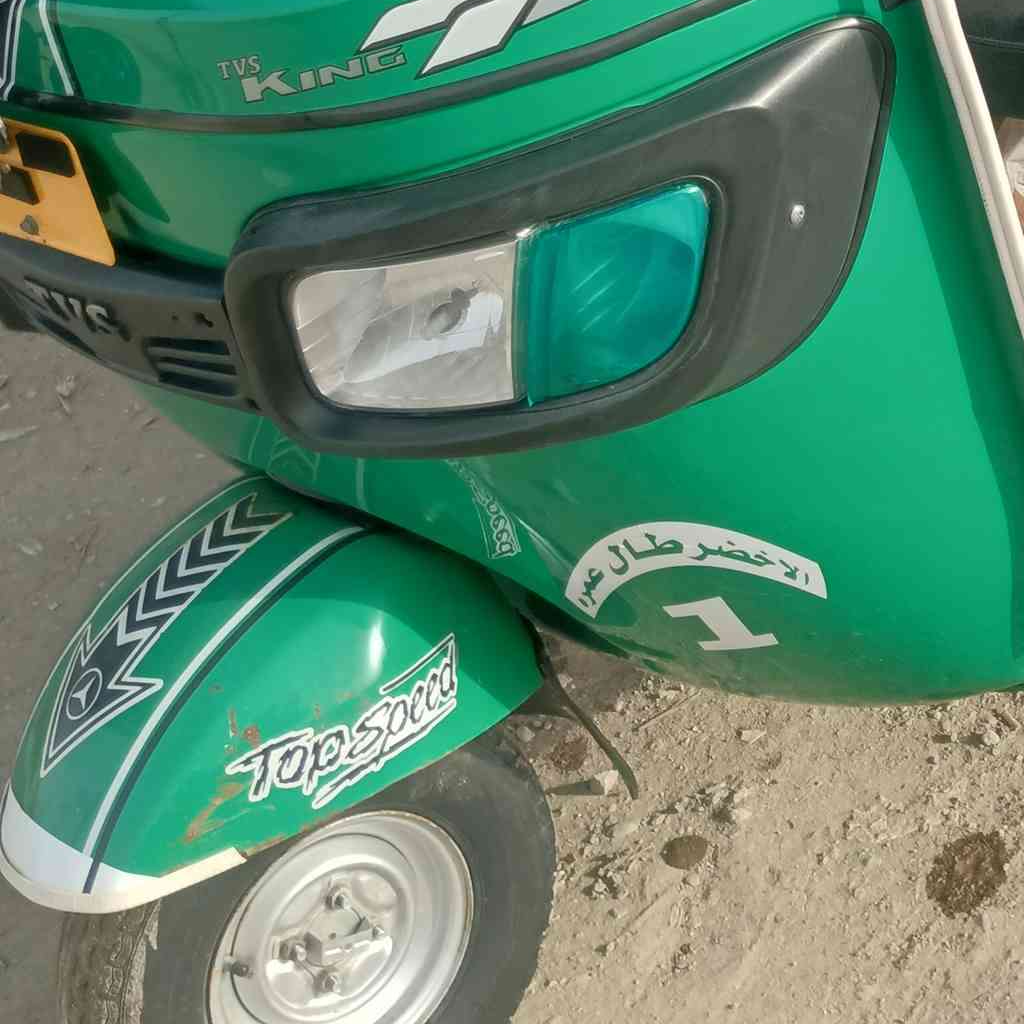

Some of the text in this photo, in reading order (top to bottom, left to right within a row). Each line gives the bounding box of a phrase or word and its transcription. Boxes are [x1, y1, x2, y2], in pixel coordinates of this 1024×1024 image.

[216, 45, 407, 104] TVS KING
[662, 596, 780, 652] 1
